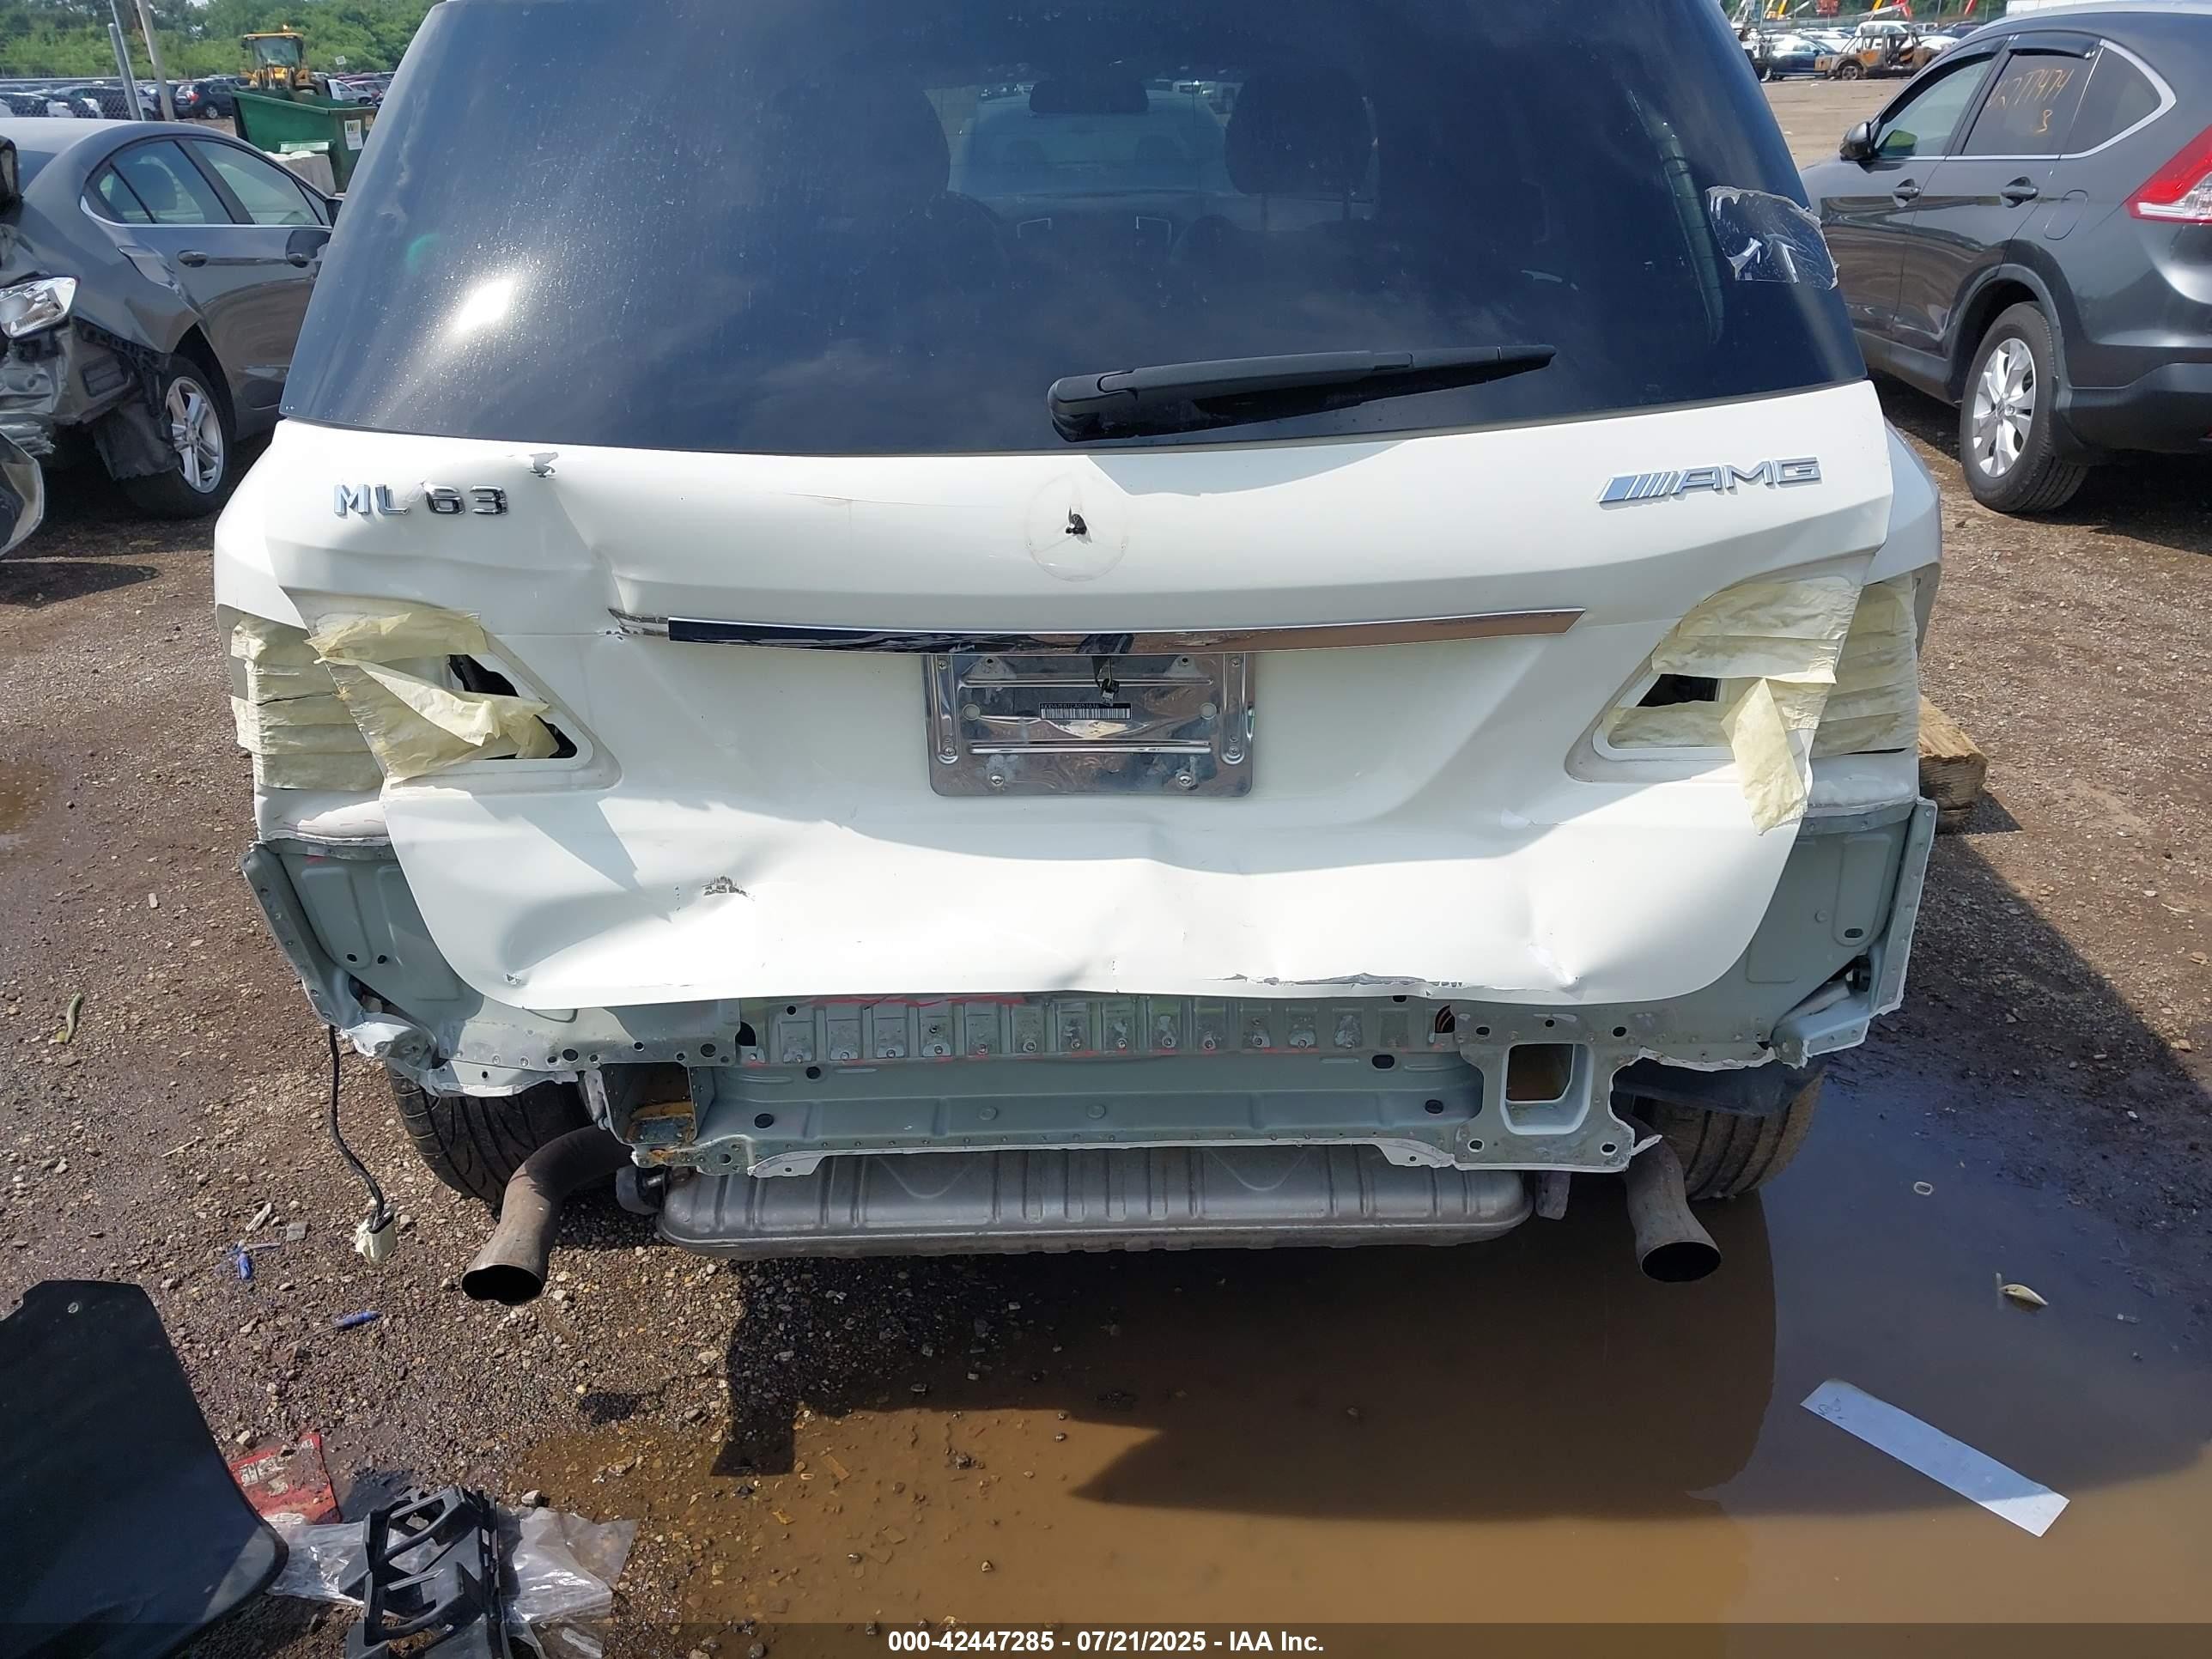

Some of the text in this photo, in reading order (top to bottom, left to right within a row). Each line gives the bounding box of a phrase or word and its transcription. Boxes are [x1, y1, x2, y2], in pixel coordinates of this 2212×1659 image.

[1670, 456, 1822, 495] AMG
[333, 483, 509, 517] ML 63
